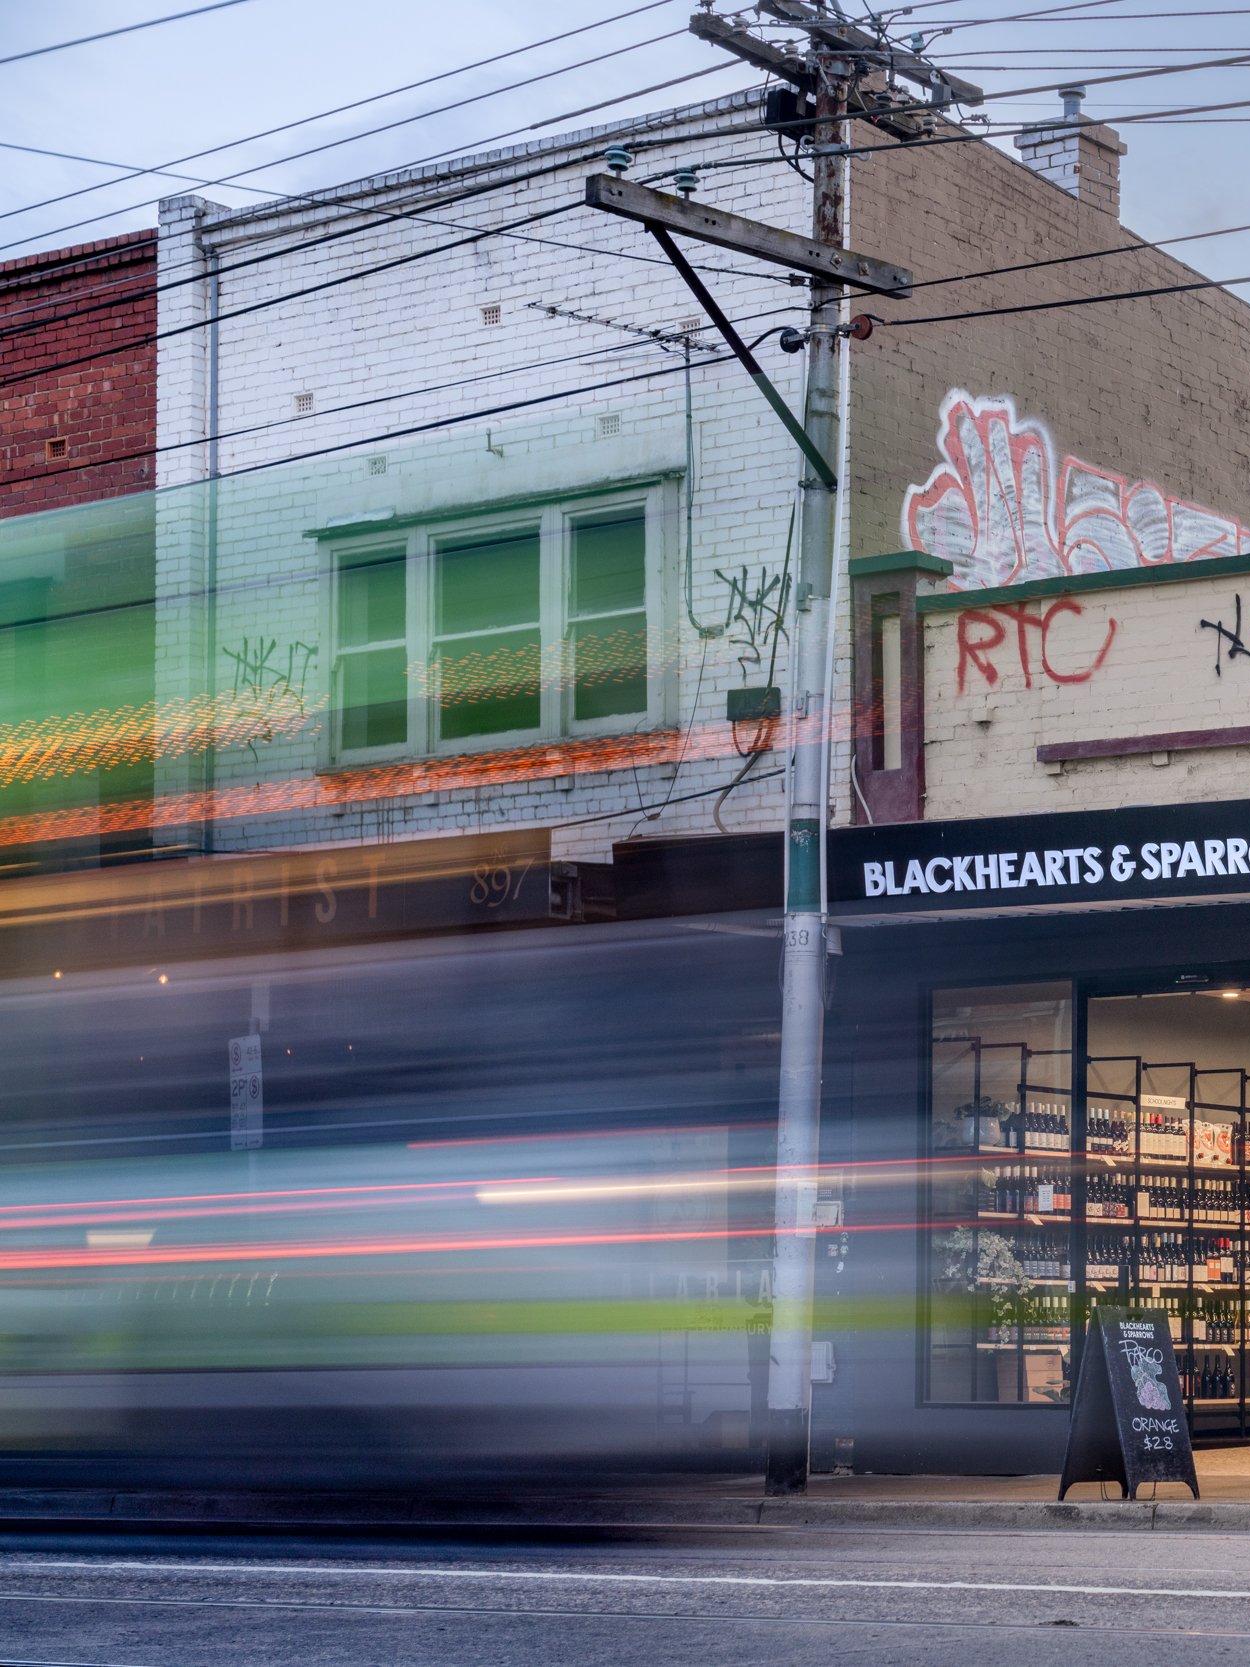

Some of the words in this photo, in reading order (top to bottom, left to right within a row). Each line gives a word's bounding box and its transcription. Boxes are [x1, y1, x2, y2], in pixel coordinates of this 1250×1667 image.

[864, 846, 1104, 897] BLACKHEARTS
[1110, 844, 1137, 882] &
[470, 857, 535, 908] 897
[1119, 1321, 1154, 1331] BLACKHEARTS
[1128, 1331, 1154, 1339] SPARROWS
[1132, 1417, 1179, 1432] ORANGE
[1144, 1434, 1173, 1450] $28
